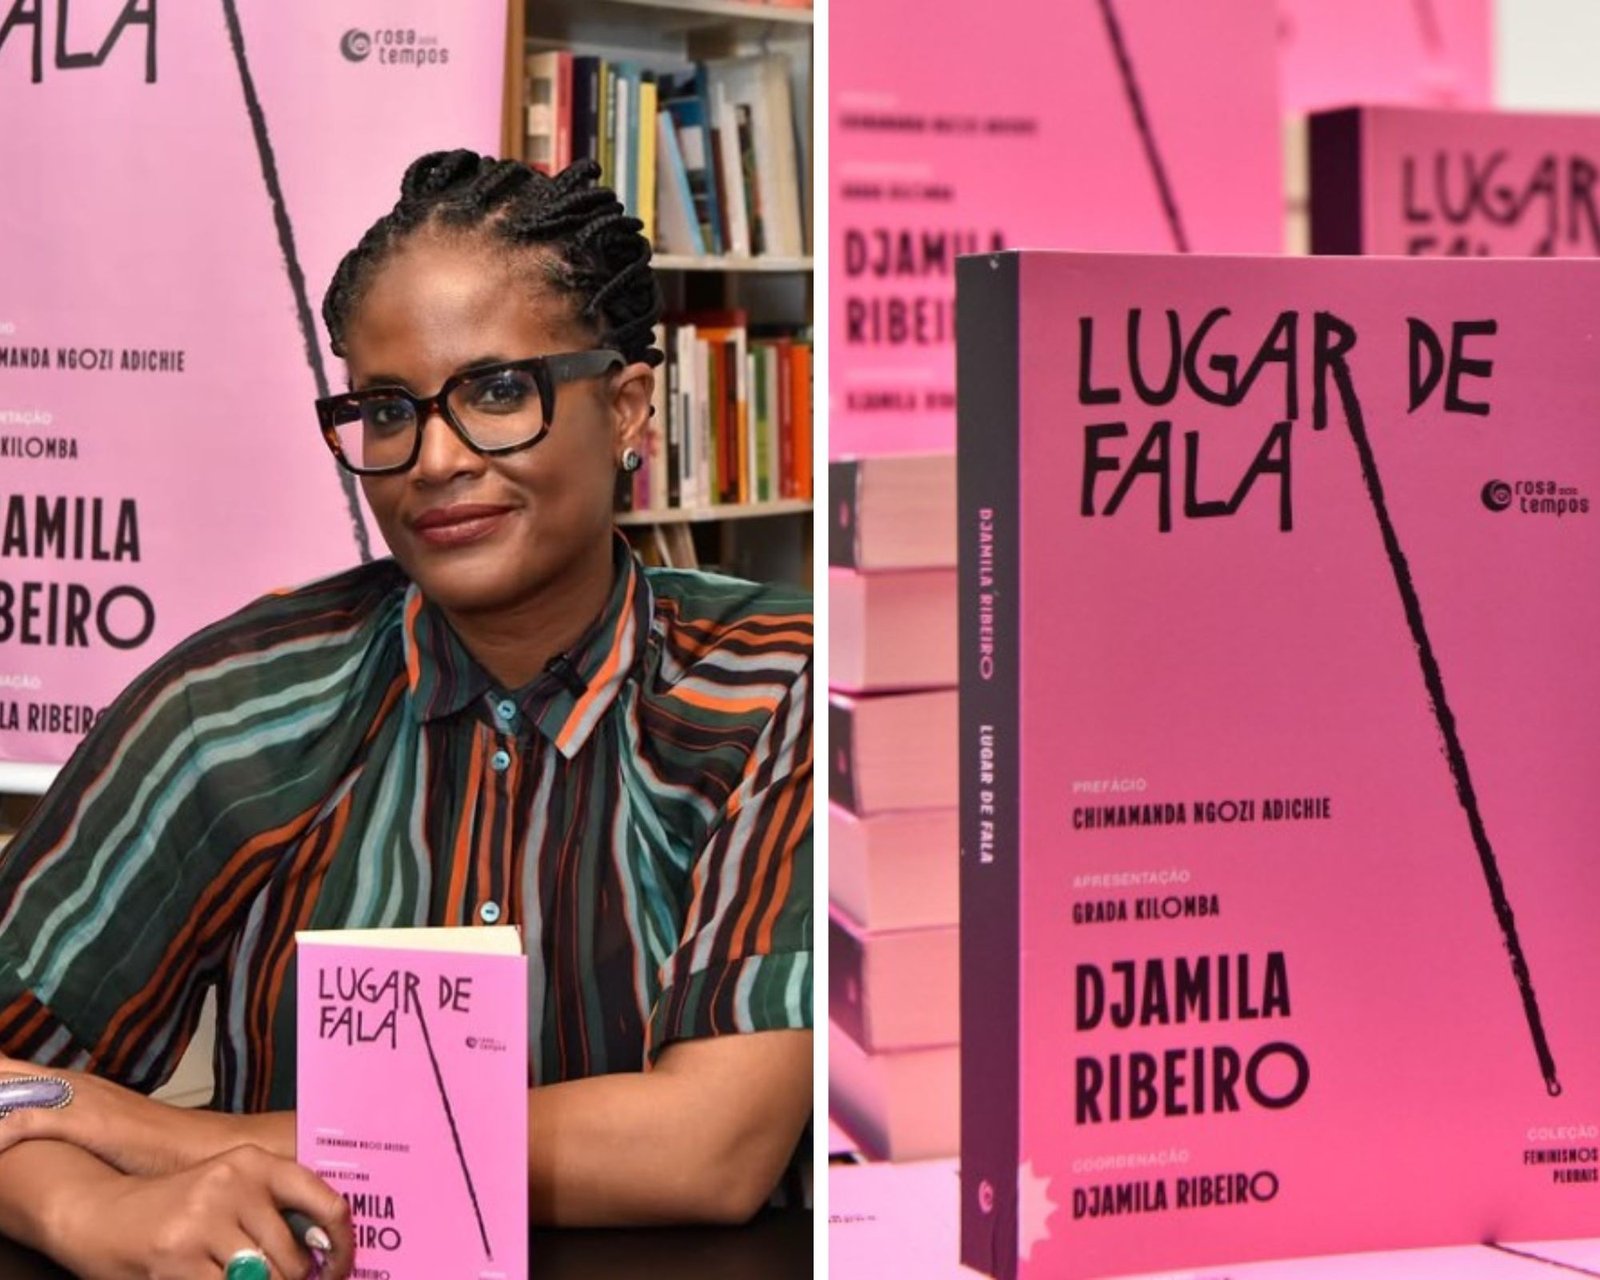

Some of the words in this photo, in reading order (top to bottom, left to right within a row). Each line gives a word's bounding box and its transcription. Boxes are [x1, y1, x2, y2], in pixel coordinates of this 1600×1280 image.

[375, 29, 416, 45] rosa
[379, 47, 449, 68] tempos
[57, 348, 113, 371] NGOZI
[120, 349, 186, 372] ADICHIE
[1079, 307, 1360, 431] LUGAR
[1406, 318, 1497, 416] DE
[0, 436, 79, 460] KILOMBA
[1080, 421, 1293, 533] FALA
[1515, 480, 1557, 496] rosa
[1520, 496, 1590, 518] tempos
[979, 508, 994, 587] DJAMILA
[979, 593, 995, 681] RIBEIRO
[979, 724, 995, 785] LUGAR
[979, 789, 995, 816] DE
[1072, 778, 1147, 794] PREFÁCIO
[1072, 803, 1187, 830] CHIMAMANDA
[1193, 800, 1255, 824] NGOZI
[1262, 798, 1332, 821] ADICHIE
[979, 820, 995, 864] FALA
[1072, 899, 1127, 925] GRADA
[1134, 894, 1220, 921] KILOMBA
[318, 967, 420, 1014] LUGAR
[438, 974, 473, 1013] DE
[1074, 950, 1292, 1033] DJAMILA
[319, 1006, 397, 1050] FALA
[1074, 1041, 1311, 1126] RIBEIRO
[1072, 1179, 1168, 1220] DJAMILA
[1176, 1170, 1280, 1209] RIBEIRO
